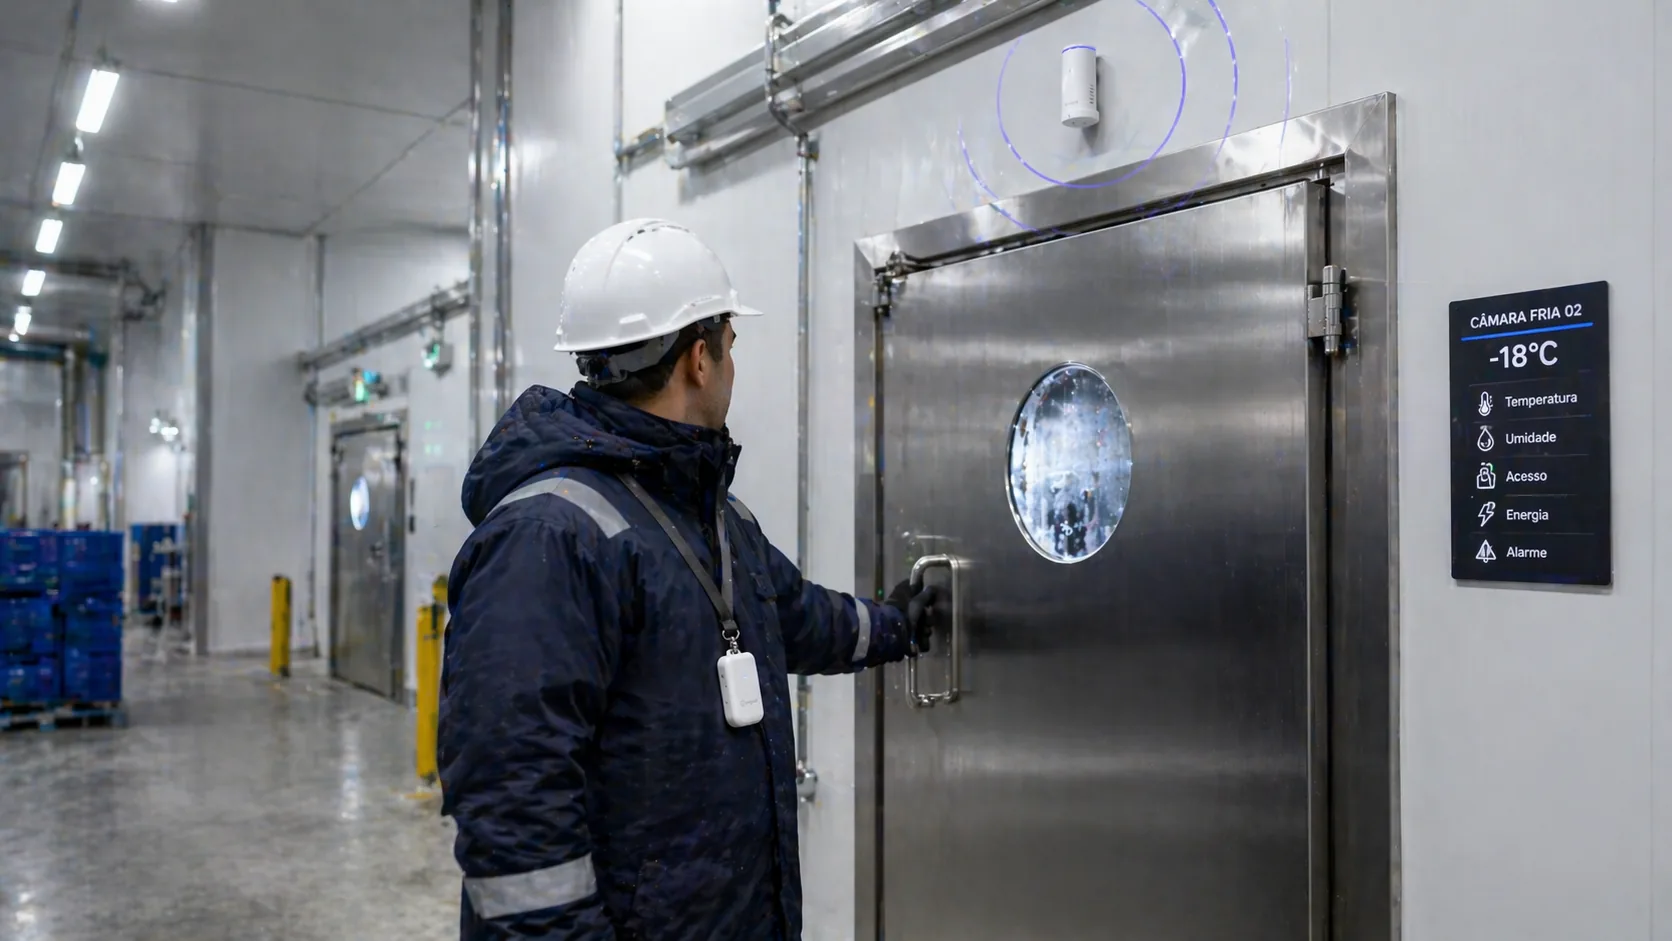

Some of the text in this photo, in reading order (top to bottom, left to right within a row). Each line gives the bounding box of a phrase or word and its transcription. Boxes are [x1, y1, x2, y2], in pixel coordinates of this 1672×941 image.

[1470, 303, 1582, 328] CÂMARA FRIA 02
[1489, 340, 1558, 368] -18°C
[1505, 393, 1578, 408] Temperatura
[1505, 431, 1557, 444] Umidade
[1505, 471, 1548, 482] Acesso
[1506, 509, 1549, 523] Energia
[1506, 546, 1547, 558] Alarme
